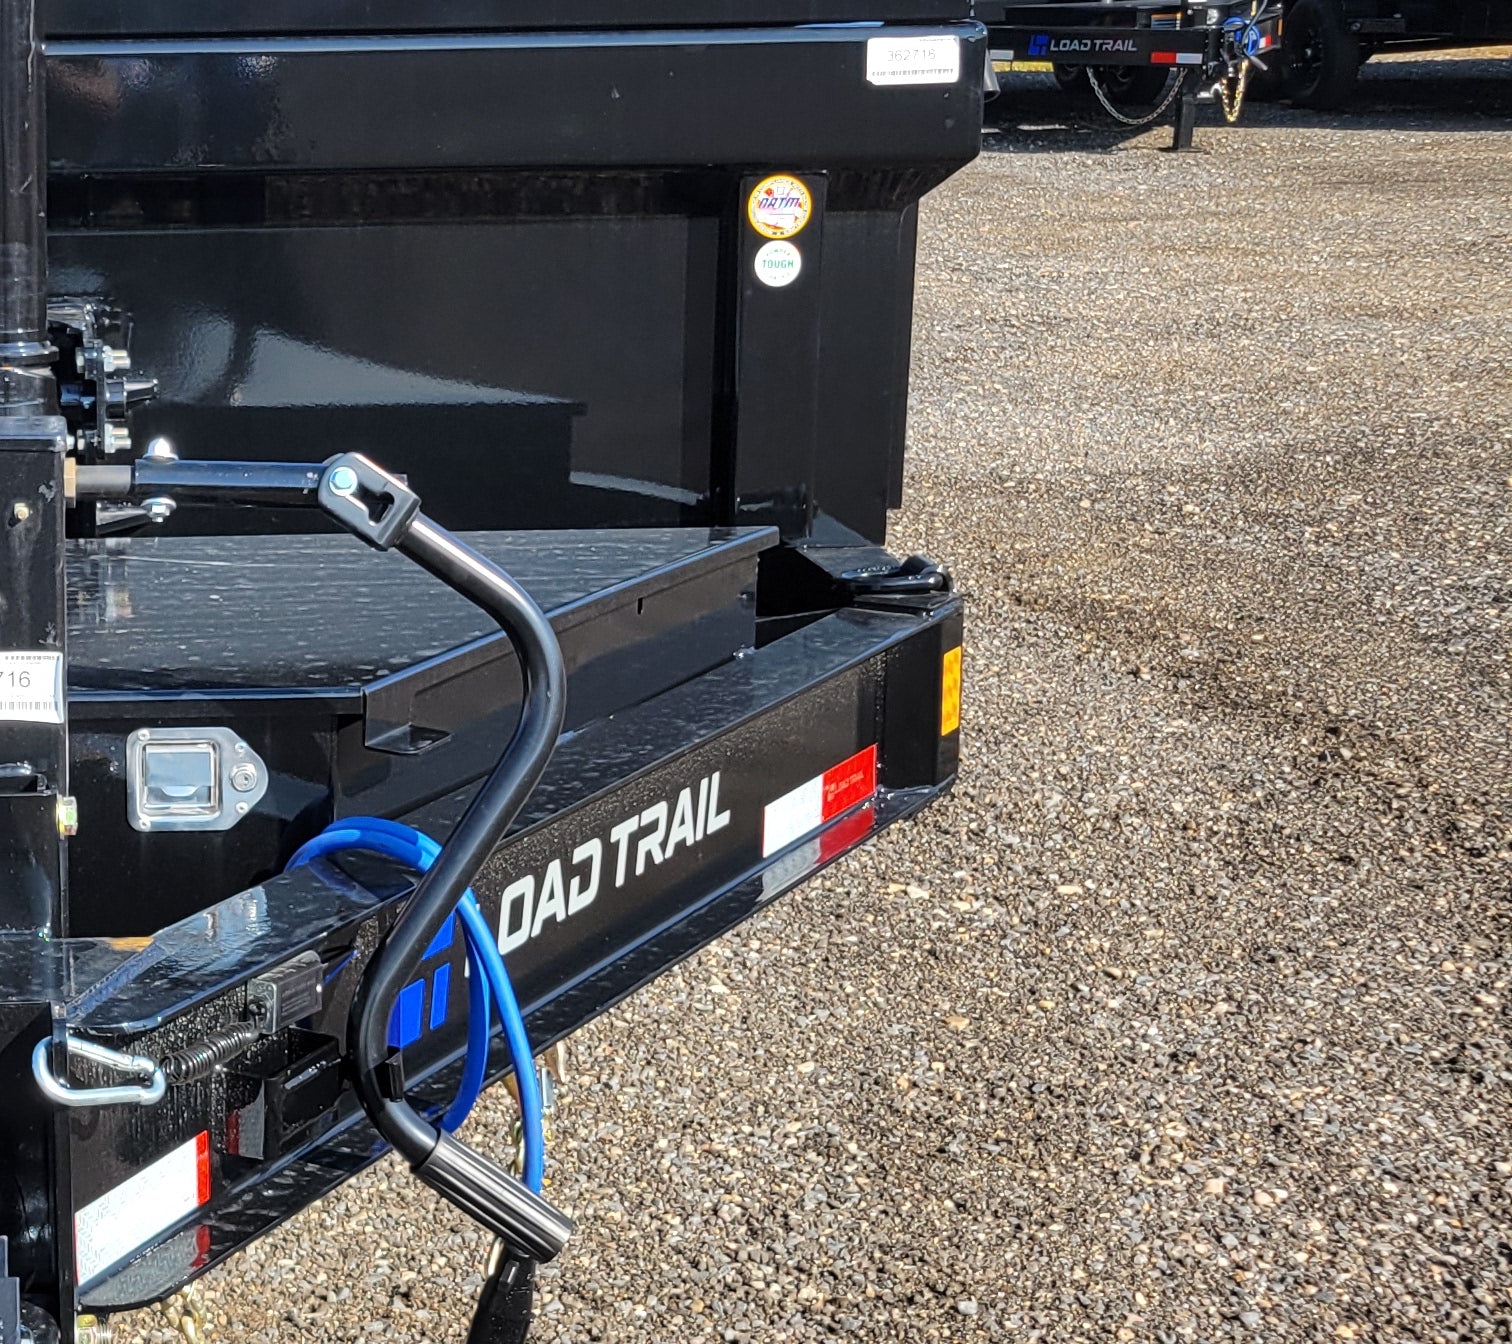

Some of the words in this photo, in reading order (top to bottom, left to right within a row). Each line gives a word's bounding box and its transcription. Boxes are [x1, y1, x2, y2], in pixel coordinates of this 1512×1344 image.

[1050, 39, 1091, 52] LOAD
[1093, 39, 1138, 52] TRAIL
[762, 258, 794, 269] TOUGH
[464, 837, 602, 977] OAD
[610, 771, 731, 888] TRAIL
